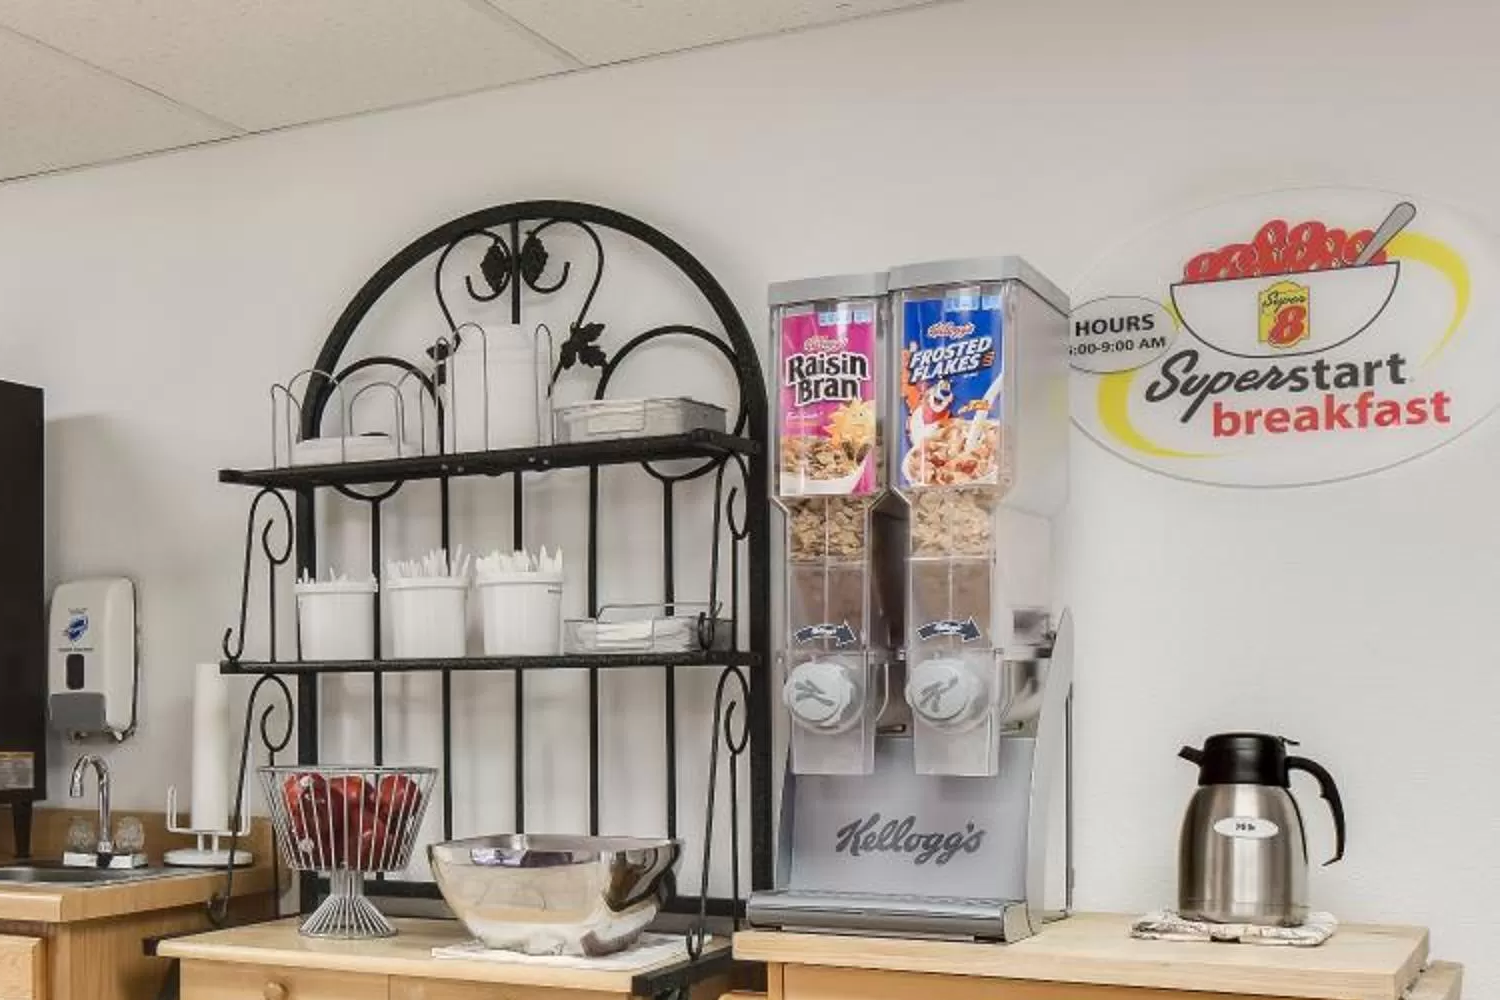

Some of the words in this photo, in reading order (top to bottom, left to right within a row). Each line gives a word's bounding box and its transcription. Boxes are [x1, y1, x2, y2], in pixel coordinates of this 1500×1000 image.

[1075, 314, 1155, 337] HOURS
[1268, 305, 1306, 346] 8
[910, 338, 992, 369] FROSTED
[1139, 336, 1166, 349] AM
[787, 353, 868, 383] Raisin
[911, 354, 980, 382] FLAKES
[798, 377, 860, 403] Bran
[1145, 349, 1408, 424] Superstart
[1212, 391, 1451, 438] breakfast
[835, 812, 988, 865] Kellogg's
